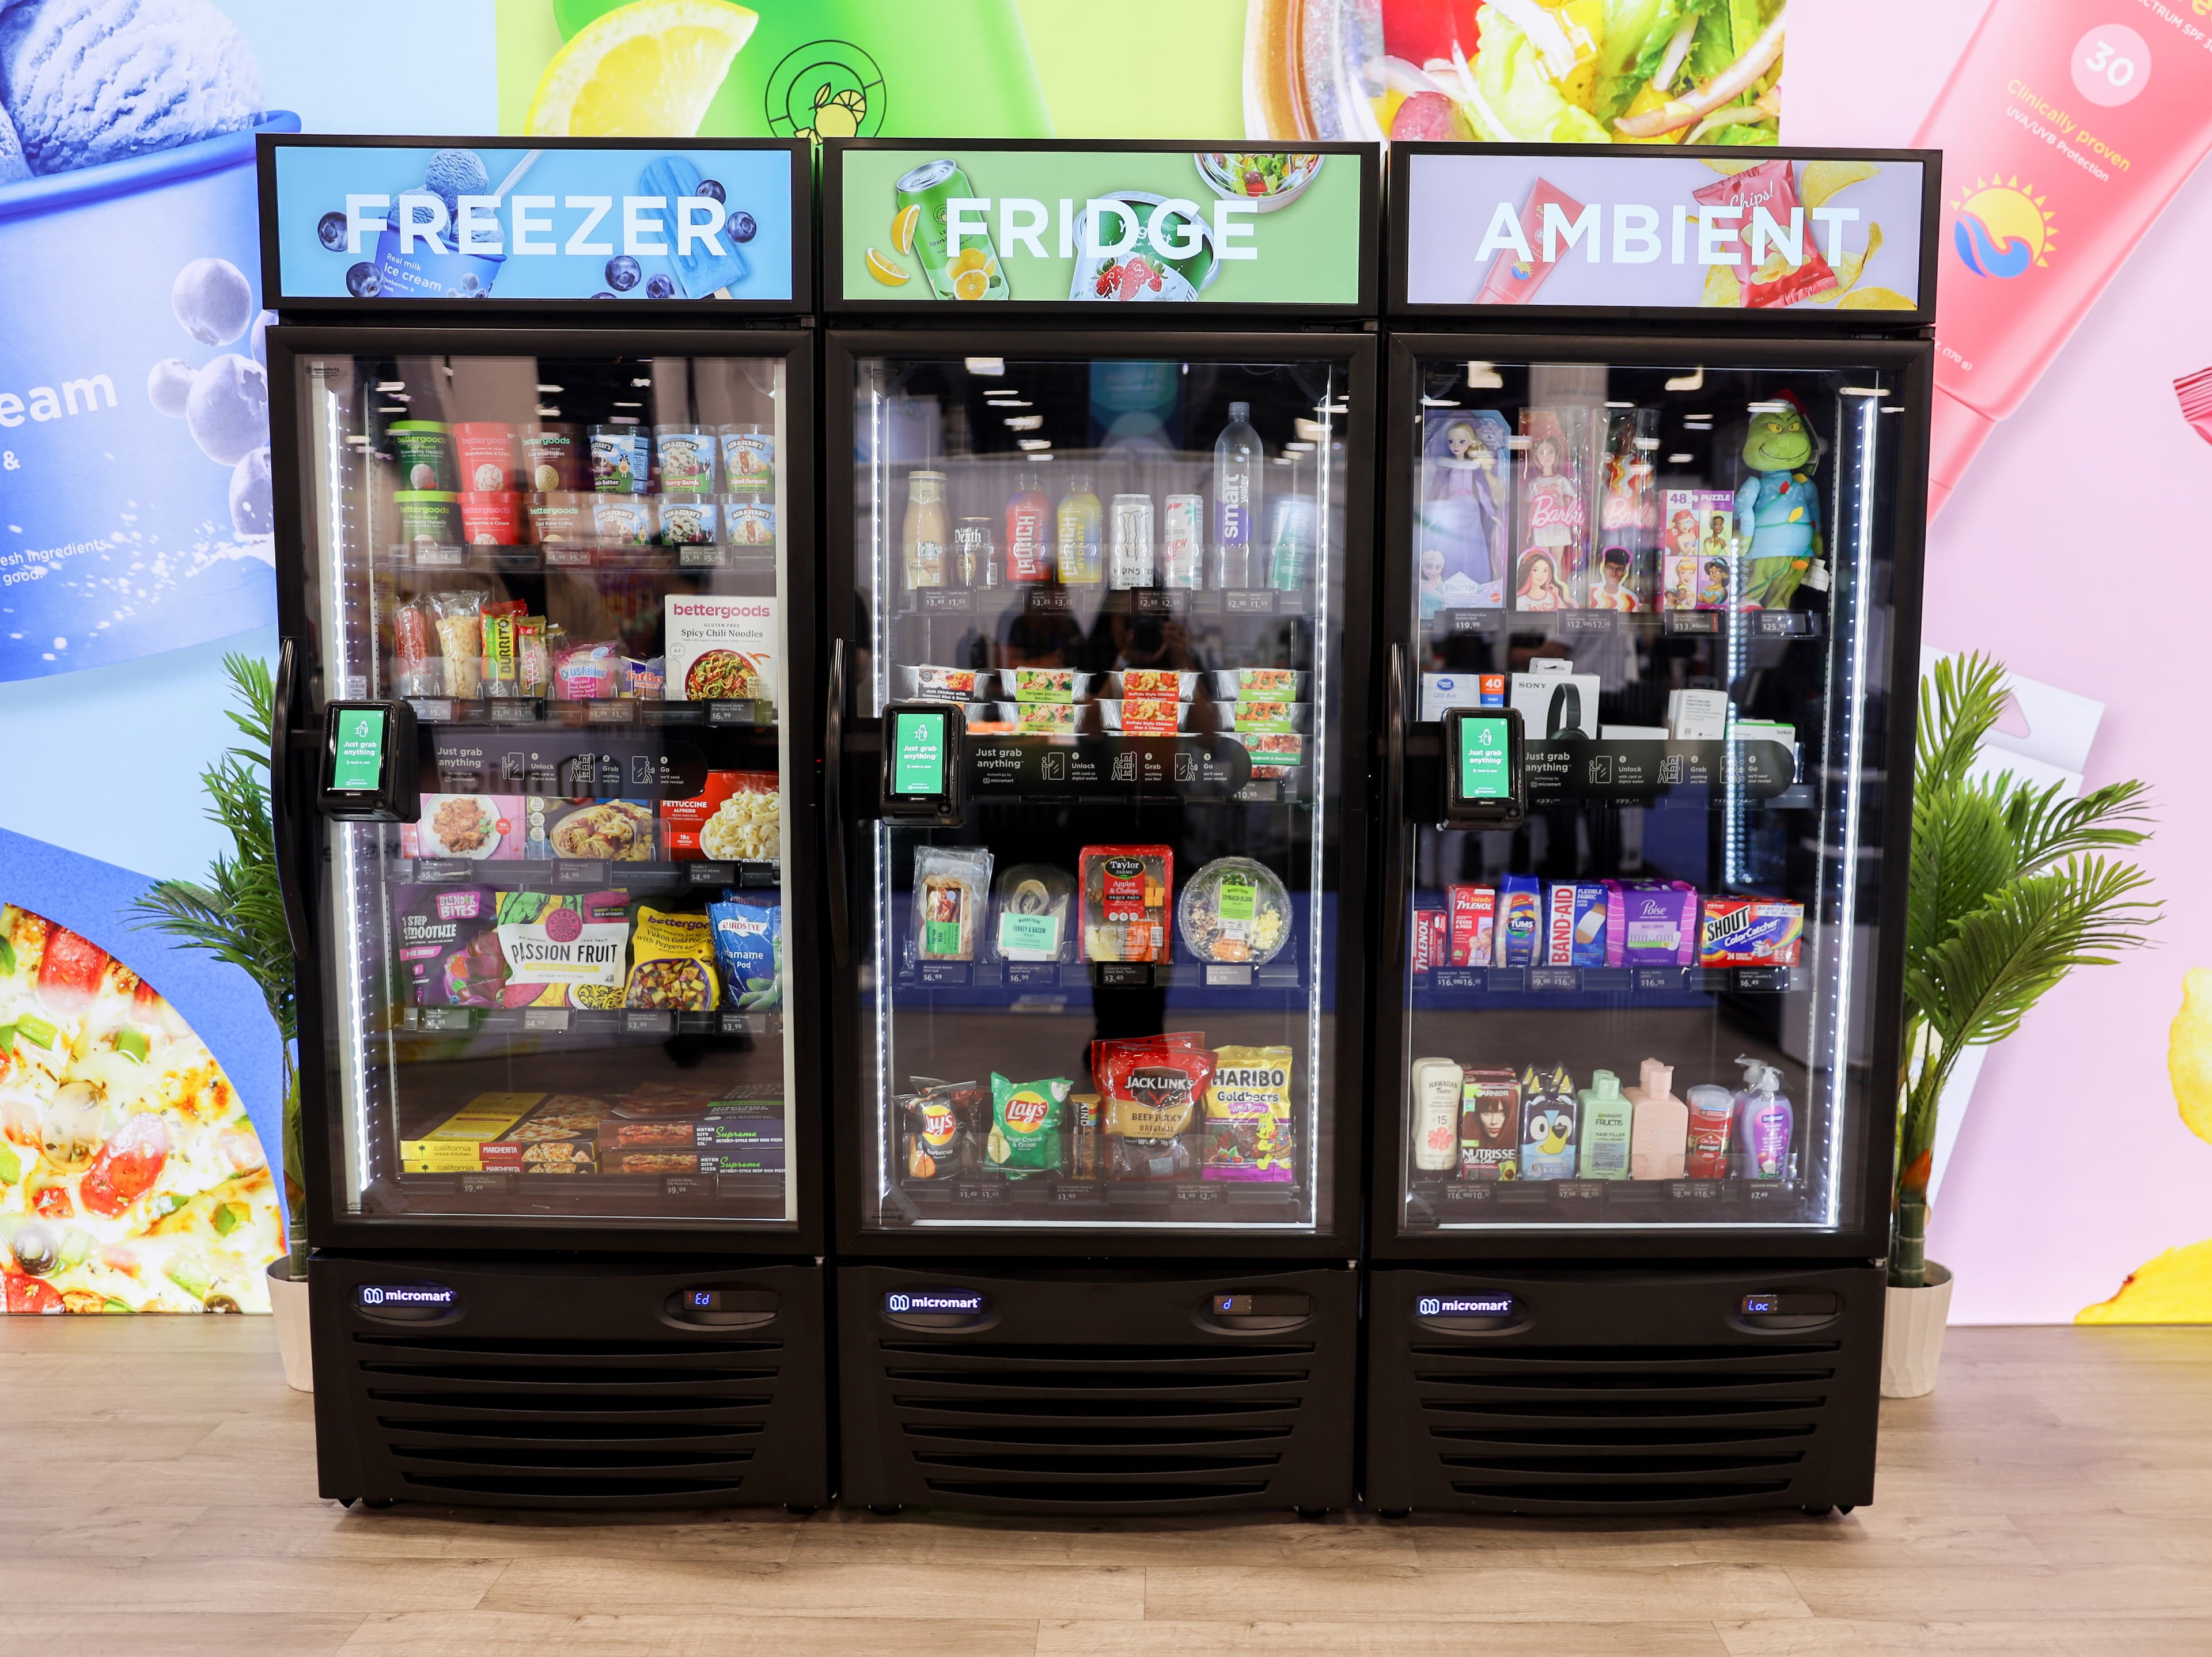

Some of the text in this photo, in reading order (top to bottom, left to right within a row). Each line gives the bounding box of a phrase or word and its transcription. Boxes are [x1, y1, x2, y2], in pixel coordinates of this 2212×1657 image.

[2138, 0, 2183, 28] CTRUM
[2181, 24, 2205, 41] SPF
[2085, 40, 2134, 86] 30
[2008, 79, 2131, 172] Clinically proven
[2006, 105, 2110, 183] UVA/UVB Protection
[1730, 180, 1774, 210] Chips!
[346, 195, 728, 255] FREEZER
[946, 198, 1259, 260] FRIDGE
[1474, 202, 1861, 267] AMBIENT
[387, 253, 422, 272] Real milk
[384, 262, 442, 292] Ice cream
[523, 437, 570, 445] bettergoods
[3, 450, 21, 471] &
[1240, 474, 1249, 504] water
[1670, 494, 1687, 504] 48
[1700, 494, 1730, 502] PUZZLE
[530, 507, 578, 515] bettergoods
[1224, 473, 1240, 539] smart
[1532, 495, 1585, 529] Barbie
[926, 598, 966, 606] $3.49 $1.99
[673, 604, 770, 619] bettergoods
[1762, 623, 1787, 631] $25.99
[681, 629, 704, 638] Spicy
[729, 630, 763, 638] Noodles
[497, 619, 512, 674] BURRITO
[1485, 679, 1502, 688] 40
[438, 748, 483, 757] Just grab
[921, 745, 937, 753] grab
[976, 748, 1022, 759] Just grab
[439, 758, 482, 768] anything
[977, 759, 1021, 769] anything
[662, 801, 707, 809] FETTUCCINE
[1109, 860, 1139, 871] Taylor
[1113, 880, 1135, 889] Apples
[440, 894, 475, 907] BLENDER
[1456, 900, 1493, 911] TYLENOL
[1640, 899, 1668, 915] Poise
[550, 911, 577, 925] PITAYA
[1707, 905, 1751, 942] SHOUT
[723, 922, 747, 930] BIRDS
[1510, 920, 1535, 928] TUMS
[1552, 888, 1574, 965] BAND-AID
[646, 929, 671, 942] Yukon
[637, 935, 683, 950] with Peppers
[1415, 919, 1429, 972] TYLENOL
[511, 942, 618, 964] PASSION FRUIT
[728, 951, 764, 960] amame
[737, 961, 751, 969] Pod
[923, 974, 942, 982] $6.99
[1104, 975, 1124, 983] $3.49
[628, 1022, 647, 1030] $3.99
[724, 1023, 742, 1032] $3.99
[1125, 1076, 1157, 1090] JACK
[1213, 1069, 1285, 1087] HARIBO
[1429, 1080, 1458, 1089] HAWAIIAN
[1476, 1089, 1509, 1097] GARNIER
[1007, 1099, 1047, 1124] Lay's
[1080, 1103, 1089, 1127] KIND
[1132, 1112, 1154, 1121] BEEF
[1437, 1116, 1448, 1125] 15
[1595, 1118, 1623, 1127] FRUCTIS
[715, 1126, 757, 1139] Supreme
[1139, 1125, 1175, 1133] ORIGINAL
[1006, 1135, 1021, 1143] Sour
[483, 1146, 518, 1154] MARGHERITA
[1462, 1148, 1516, 1159] NUTRISSE
[464, 1185, 483, 1193] $9.49
[386, 1290, 451, 1302] micromart
[695, 1293, 710, 1305] Ed
[912, 1297, 978, 1309] micromart
[1222, 1298, 1233, 1310] d
[1442, 1300, 1508, 1311] micromart
[1748, 1299, 1768, 1311] Loc
